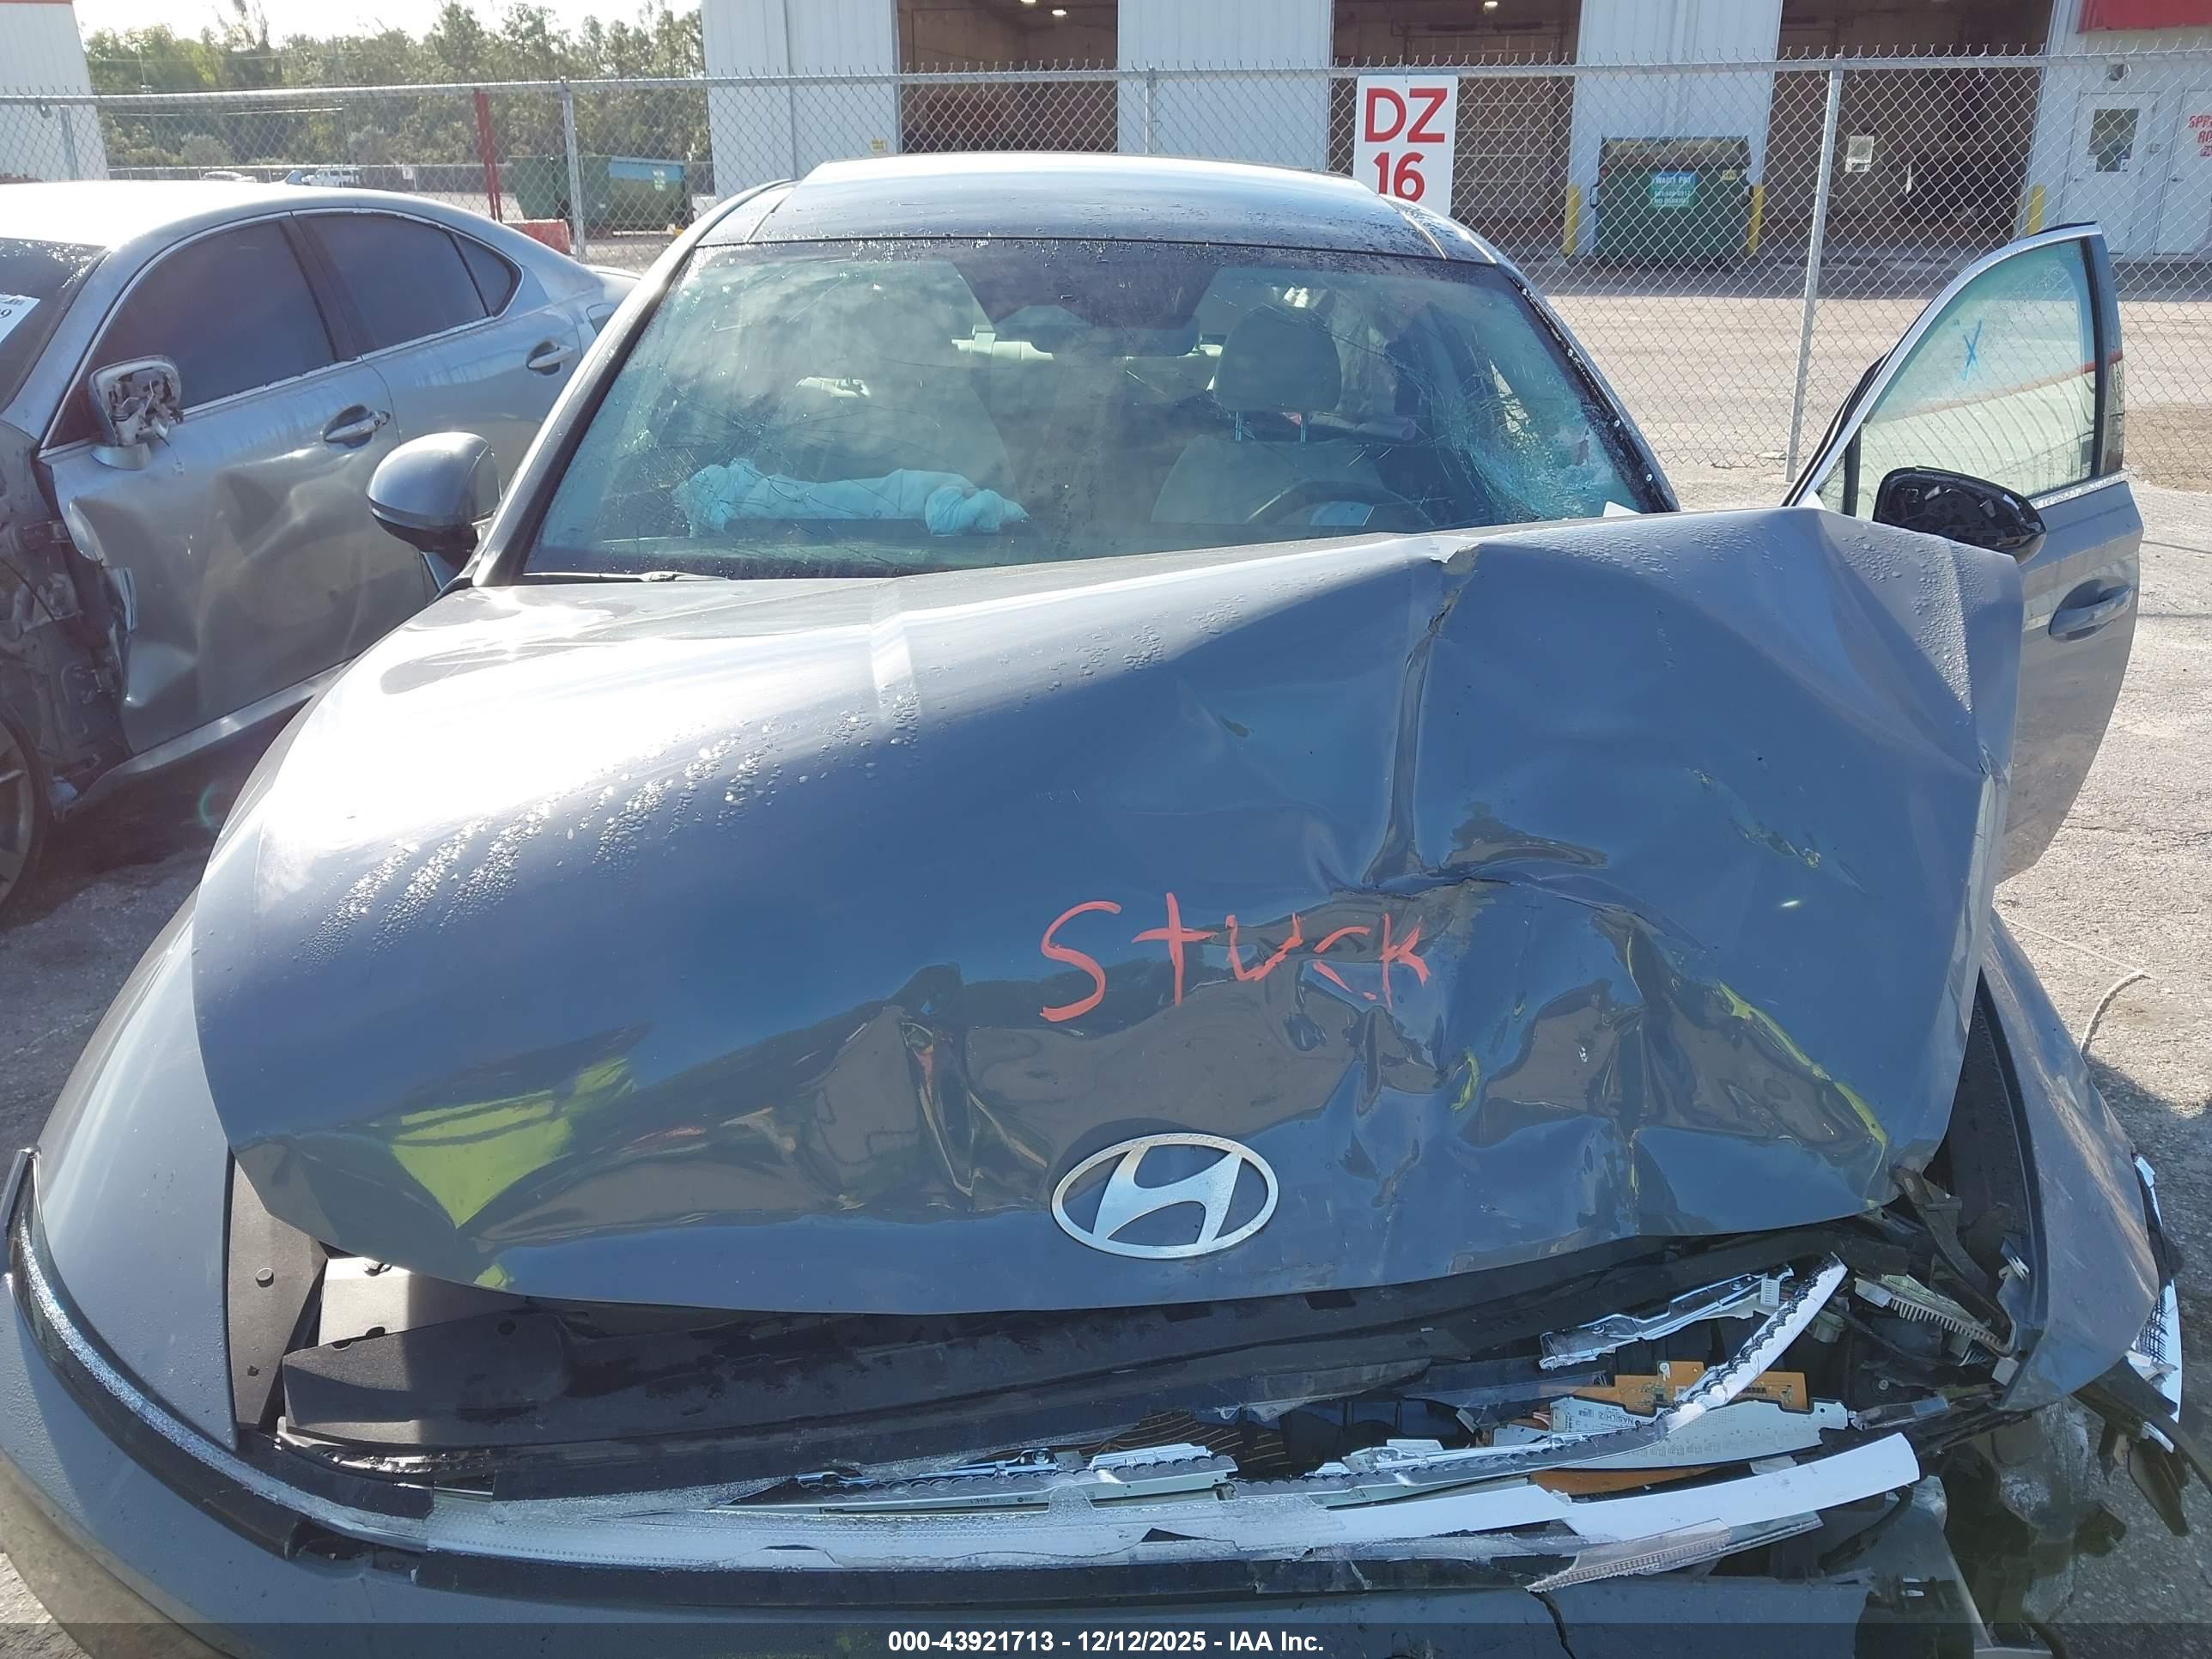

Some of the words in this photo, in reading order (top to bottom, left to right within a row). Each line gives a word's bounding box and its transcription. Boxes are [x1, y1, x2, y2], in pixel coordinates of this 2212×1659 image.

[1364, 88, 1448, 143] DZ
[2189, 115, 2212, 128] SPR
[1373, 151, 1425, 203] 16
